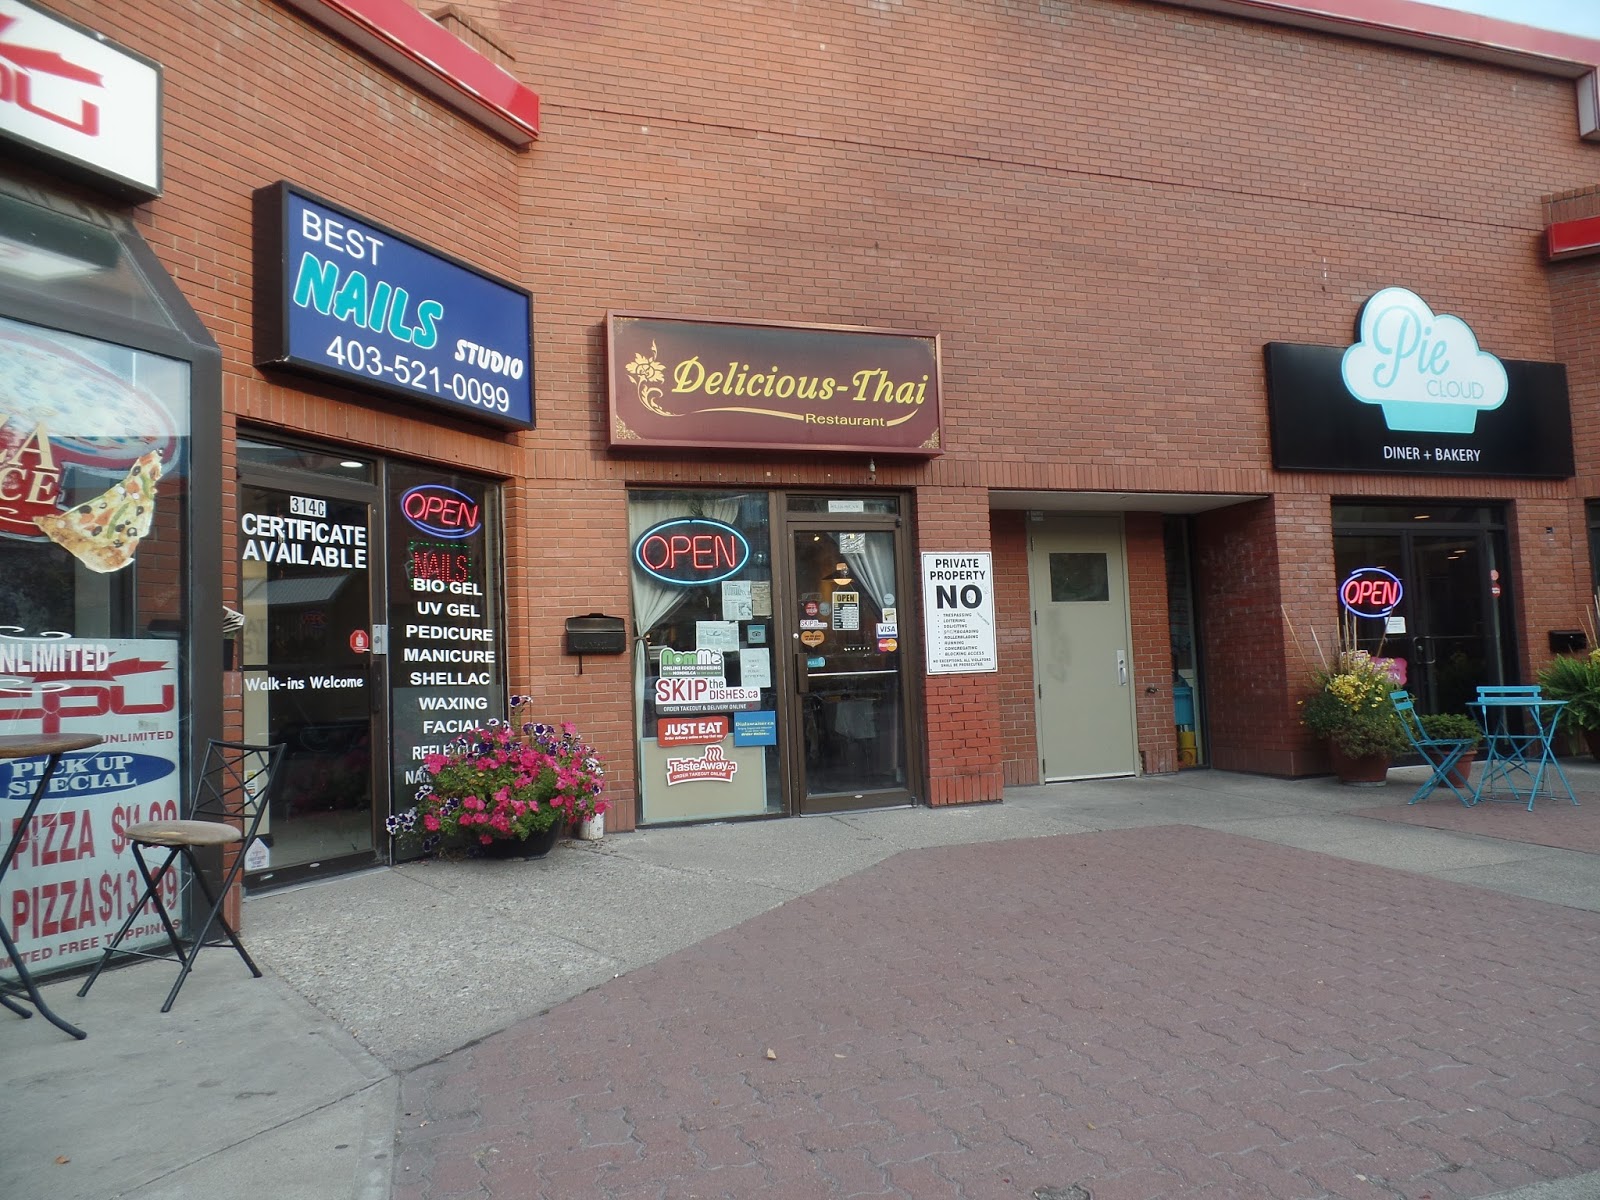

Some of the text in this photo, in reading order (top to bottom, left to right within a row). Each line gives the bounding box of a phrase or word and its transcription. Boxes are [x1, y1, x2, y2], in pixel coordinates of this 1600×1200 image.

[302, 209, 383, 266] BEST
[293, 251, 444, 350] NAILS
[1372, 305, 1450, 389] Pie
[454, 339, 523, 380] STUDIO
[326, 335, 509, 413] 403-521-0099
[671, 355, 929, 405] Delicious-Thai
[1426, 380, 1484, 399] CLOUD
[805, 412, 885, 427] Restaurant
[1383, 446, 1420, 460] DINER
[1435, 448, 1481, 462] BAKERY
[291, 497, 325, 516] 314C
[405, 493, 478, 527] OPEN
[241, 513, 366, 546] CERTIFICATE
[242, 539, 367, 568] AVAILABLE
[642, 535, 736, 570] OPEN
[935, 558, 979, 568] PRIVATE
[414, 552, 467, 582] NAILS
[930, 570, 986, 580] PROPERTY
[413, 577, 483, 596] BIO GEL
[936, 584, 982, 609] NO
[1344, 580, 1398, 605] OPEN
[836, 594, 855, 602] OPEN
[417, 601, 481, 618] UV GEL
[405, 624, 493, 642] PEDICURE
[403, 648, 496, 663] MANICURE
[244, 675, 364, 691] Walk-ins Welcome
[410, 672, 490, 685] SHELLAC
[657, 679, 759, 702] SKIP the DISHES.ca
[418, 697, 488, 710] WAXING
[102, 730, 174, 744] UNLIMITED
[664, 722, 722, 736] JUST EAT
[11, 756, 133, 778] PICK UP
[12, 809, 95, 870] PIZZA
[12, 878, 96, 943] PIZZA
[59, 936, 99, 956] FREE
